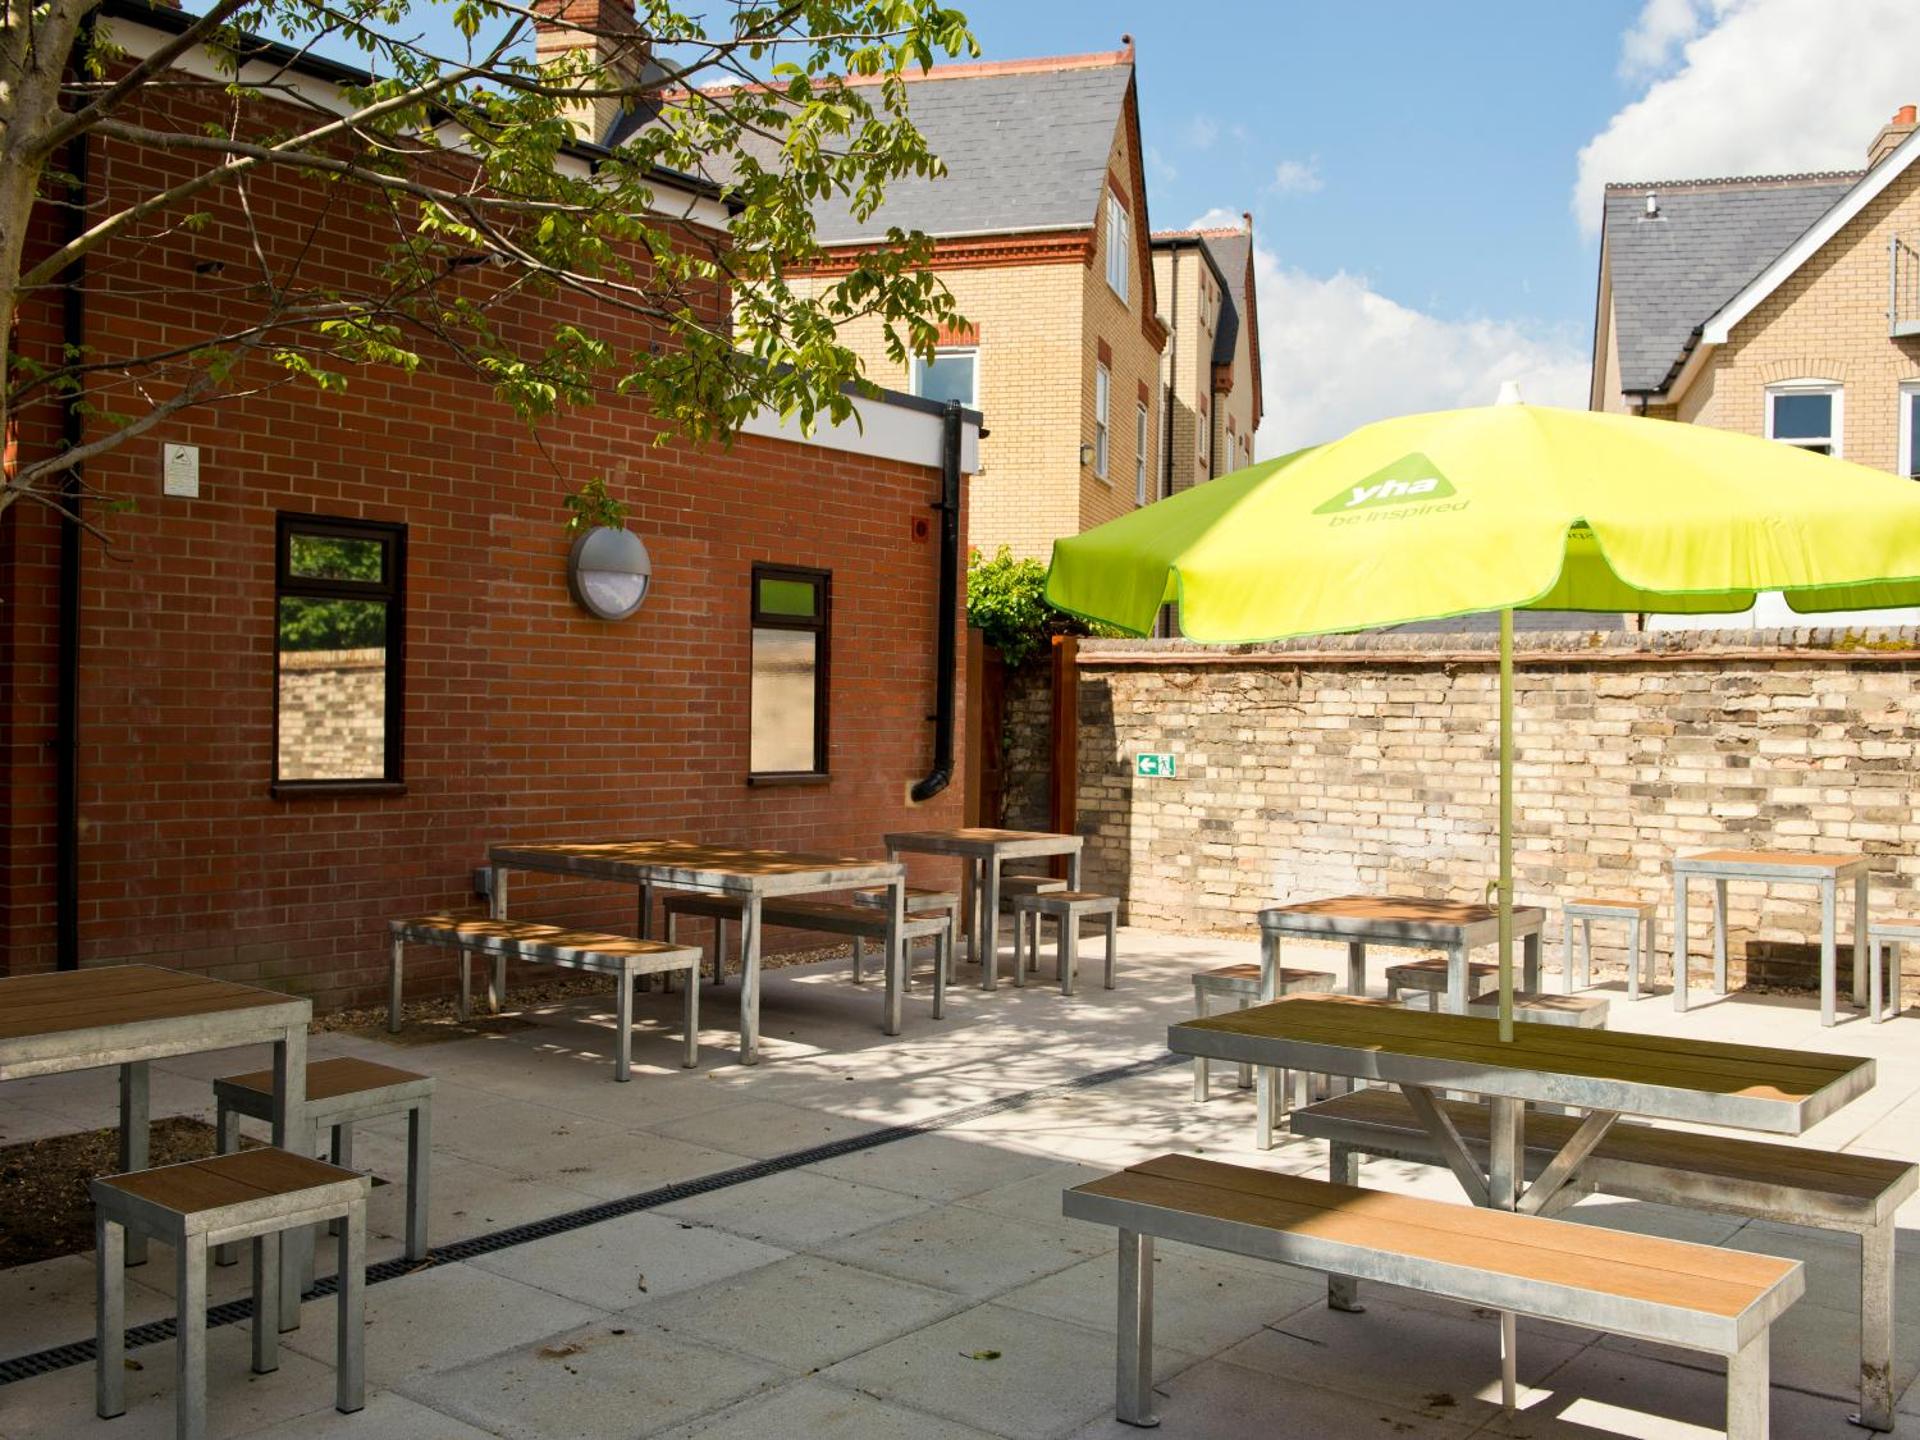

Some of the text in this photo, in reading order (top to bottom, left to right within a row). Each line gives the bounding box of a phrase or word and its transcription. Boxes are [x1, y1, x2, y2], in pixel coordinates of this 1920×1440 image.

[1344, 478, 1439, 508] yha
[1328, 499, 1471, 527] be inspired
